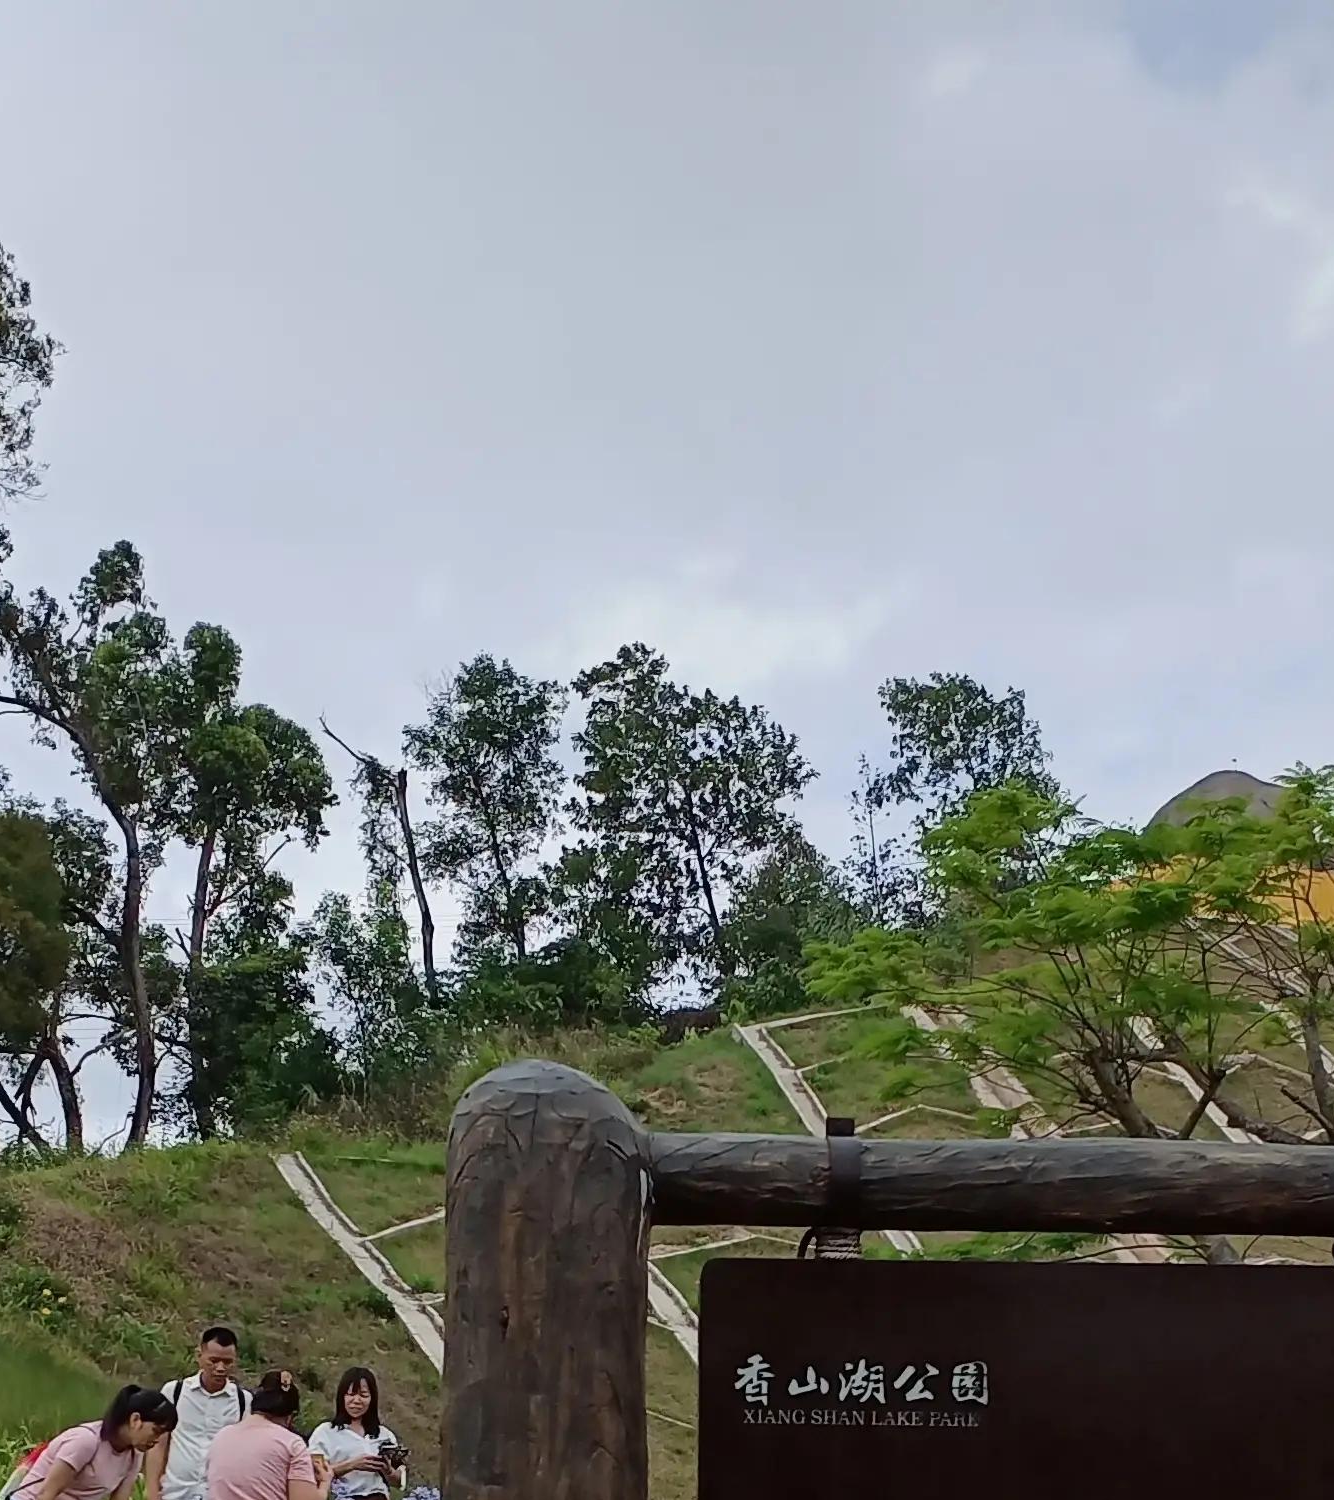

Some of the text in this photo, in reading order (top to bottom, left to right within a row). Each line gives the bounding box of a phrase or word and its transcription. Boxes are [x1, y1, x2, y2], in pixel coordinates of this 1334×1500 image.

[743, 1409, 980, 1428] XIANG SHAN LAKE PARK
